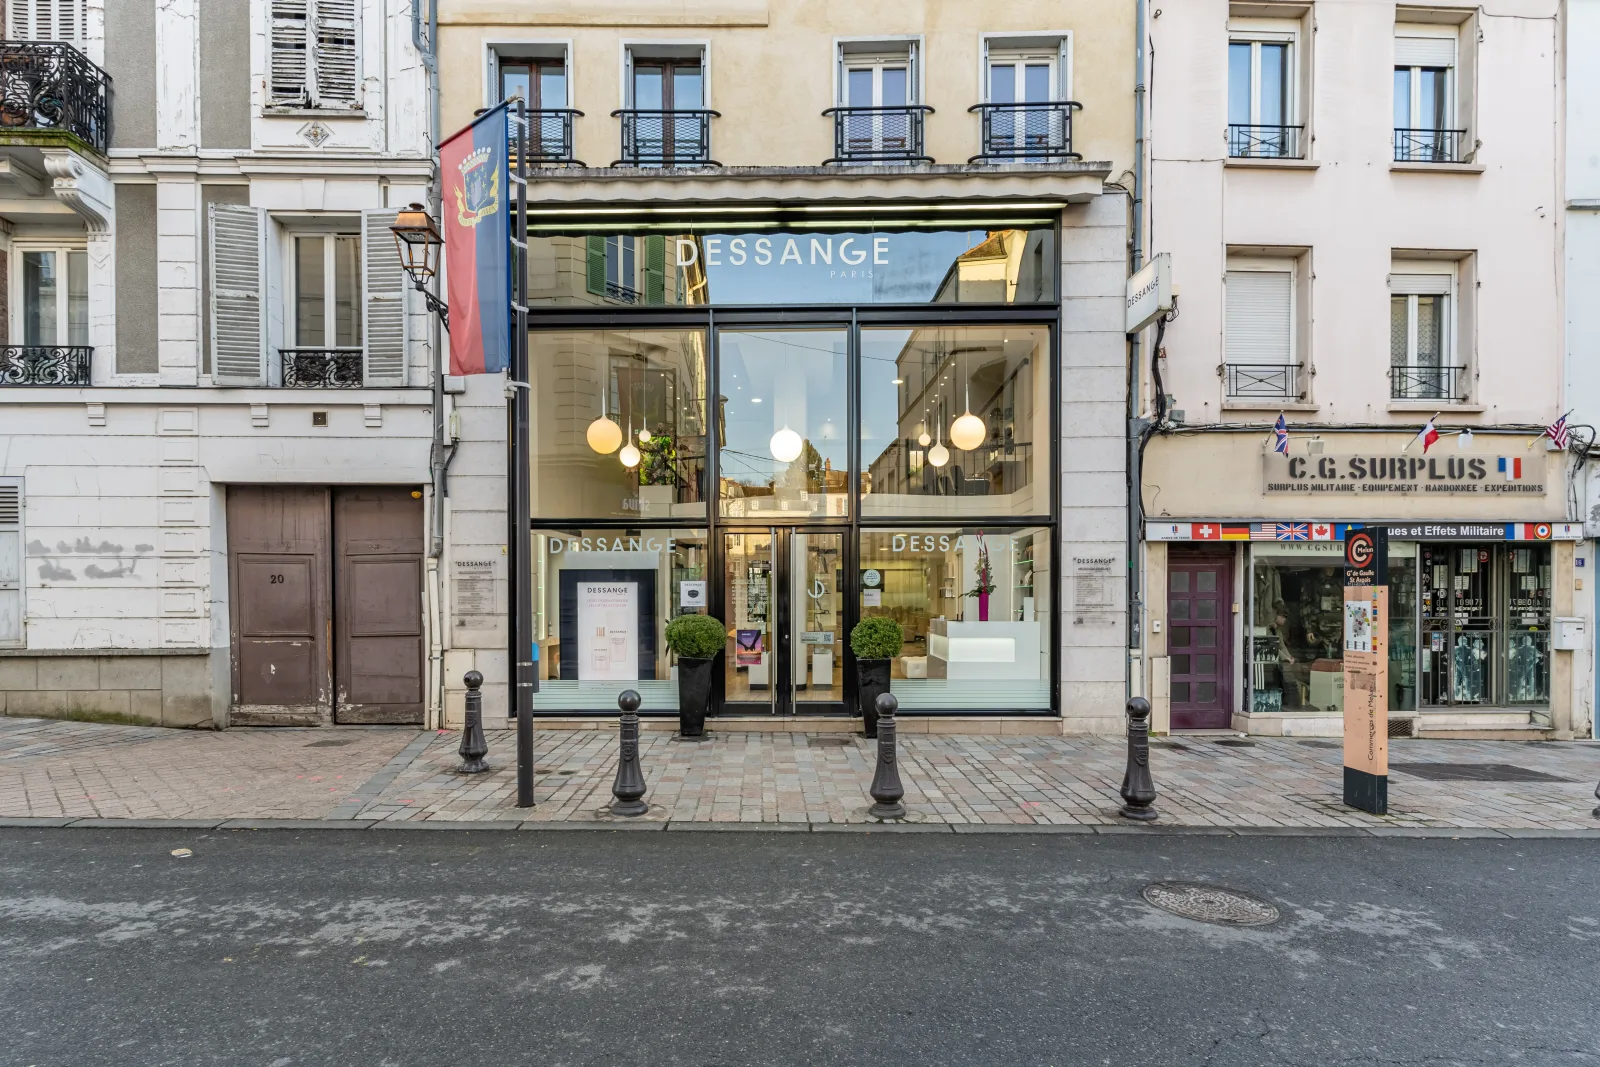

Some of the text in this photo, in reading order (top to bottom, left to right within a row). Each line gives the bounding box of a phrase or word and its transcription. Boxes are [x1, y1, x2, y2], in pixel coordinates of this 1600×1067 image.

[676, 237, 889, 266] DESSANGE
[830, 270, 874, 279] PARIS
[1127, 276, 1159, 309] DESSANGE
[1288, 457, 1487, 480] C.G.SURPLUS
[1267, 483, 1543, 492] SURPLUS MILITAIRE EQUIPEMENT RANDONNEE EXPEDITIONS
[1410, 526, 1422, 536] et
[1424, 526, 1457, 536] Effets
[1460, 526, 1504, 536] Militaire
[549, 537, 676, 554] DESSANGE
[270, 574, 284, 584] 20
